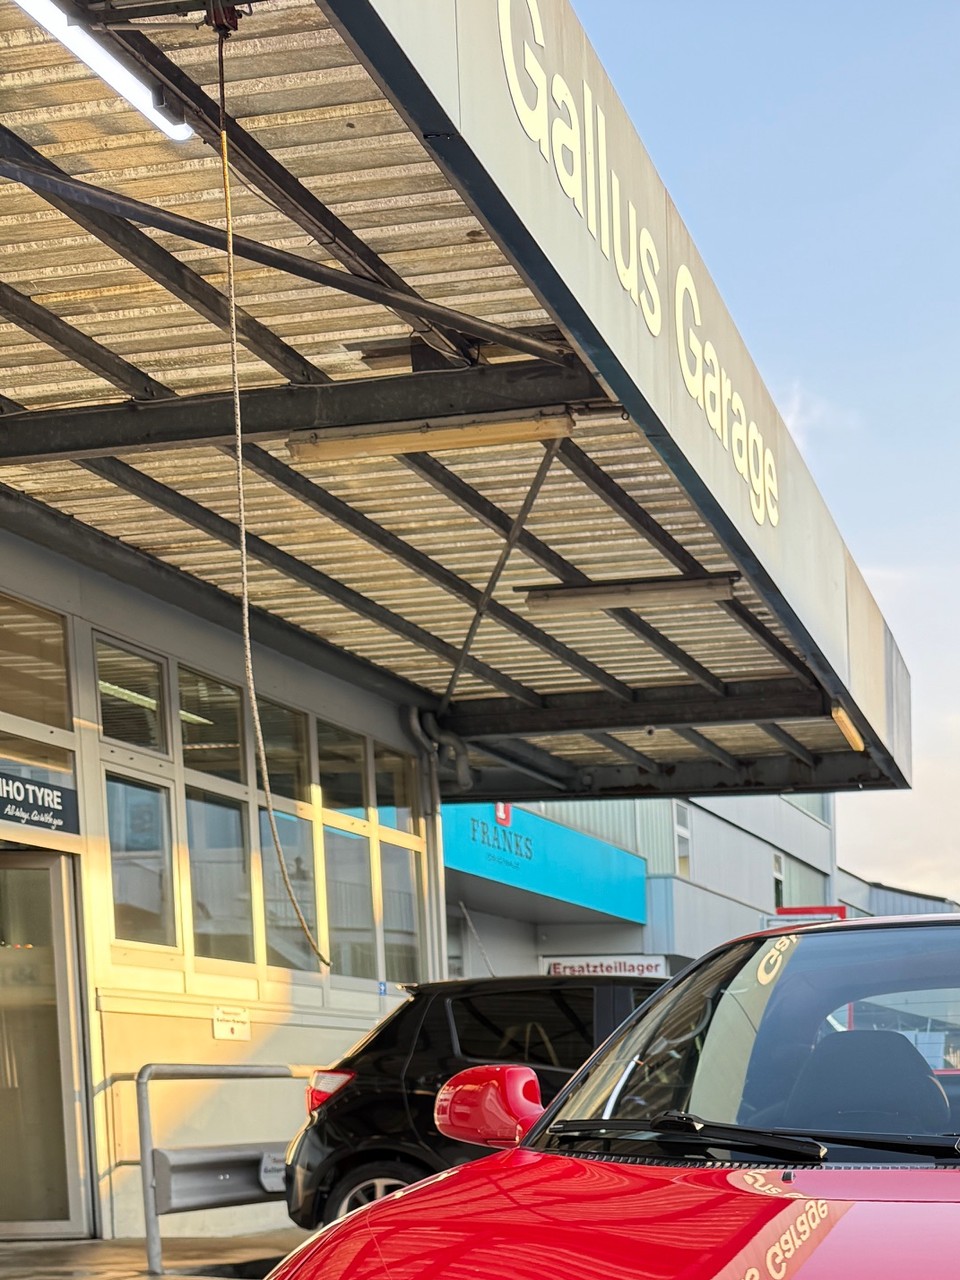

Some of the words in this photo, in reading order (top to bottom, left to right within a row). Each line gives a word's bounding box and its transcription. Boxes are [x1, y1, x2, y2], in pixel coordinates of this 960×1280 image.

[498, 0, 661, 338] Gallus
[675, 264, 779, 528] Garage
[25, 783, 63, 811] TYRE
[469, 816, 534, 861] FRANKS
[551, 961, 661, 976] Ersatzteillager
